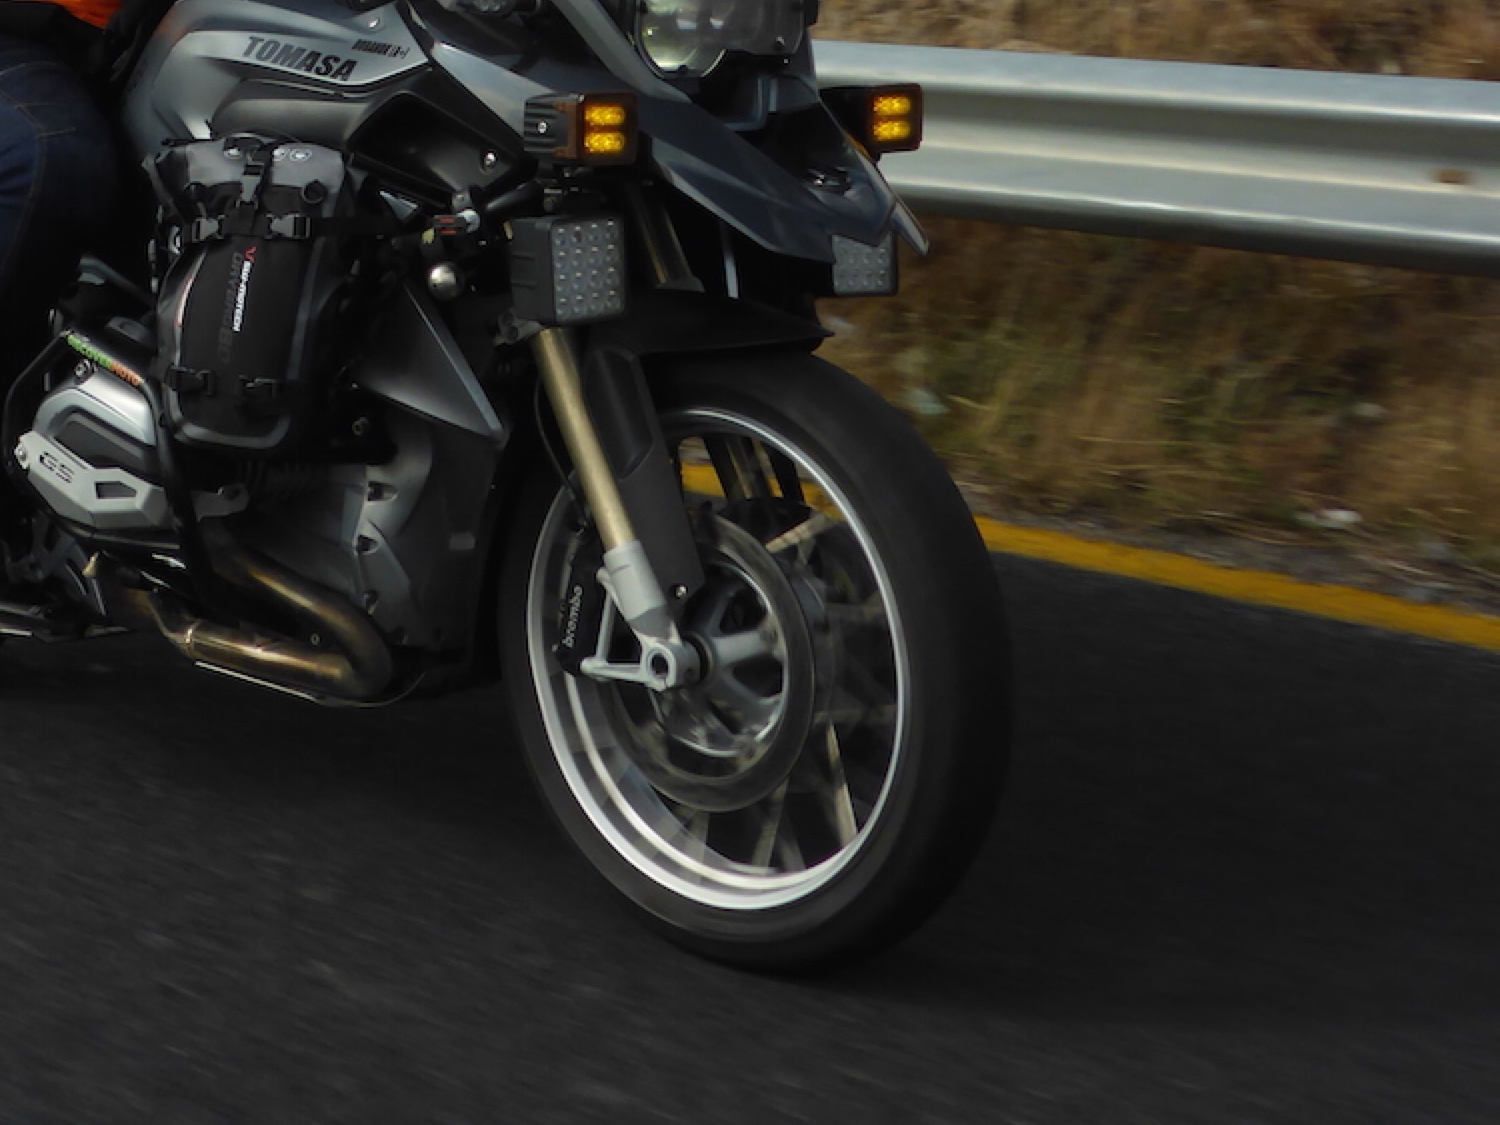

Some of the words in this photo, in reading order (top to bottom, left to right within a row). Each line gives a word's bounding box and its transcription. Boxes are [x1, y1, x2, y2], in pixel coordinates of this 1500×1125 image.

[242, 36, 358, 82] TOMASA
[39, 451, 75, 484] GS
[561, 584, 584, 649] brembo
